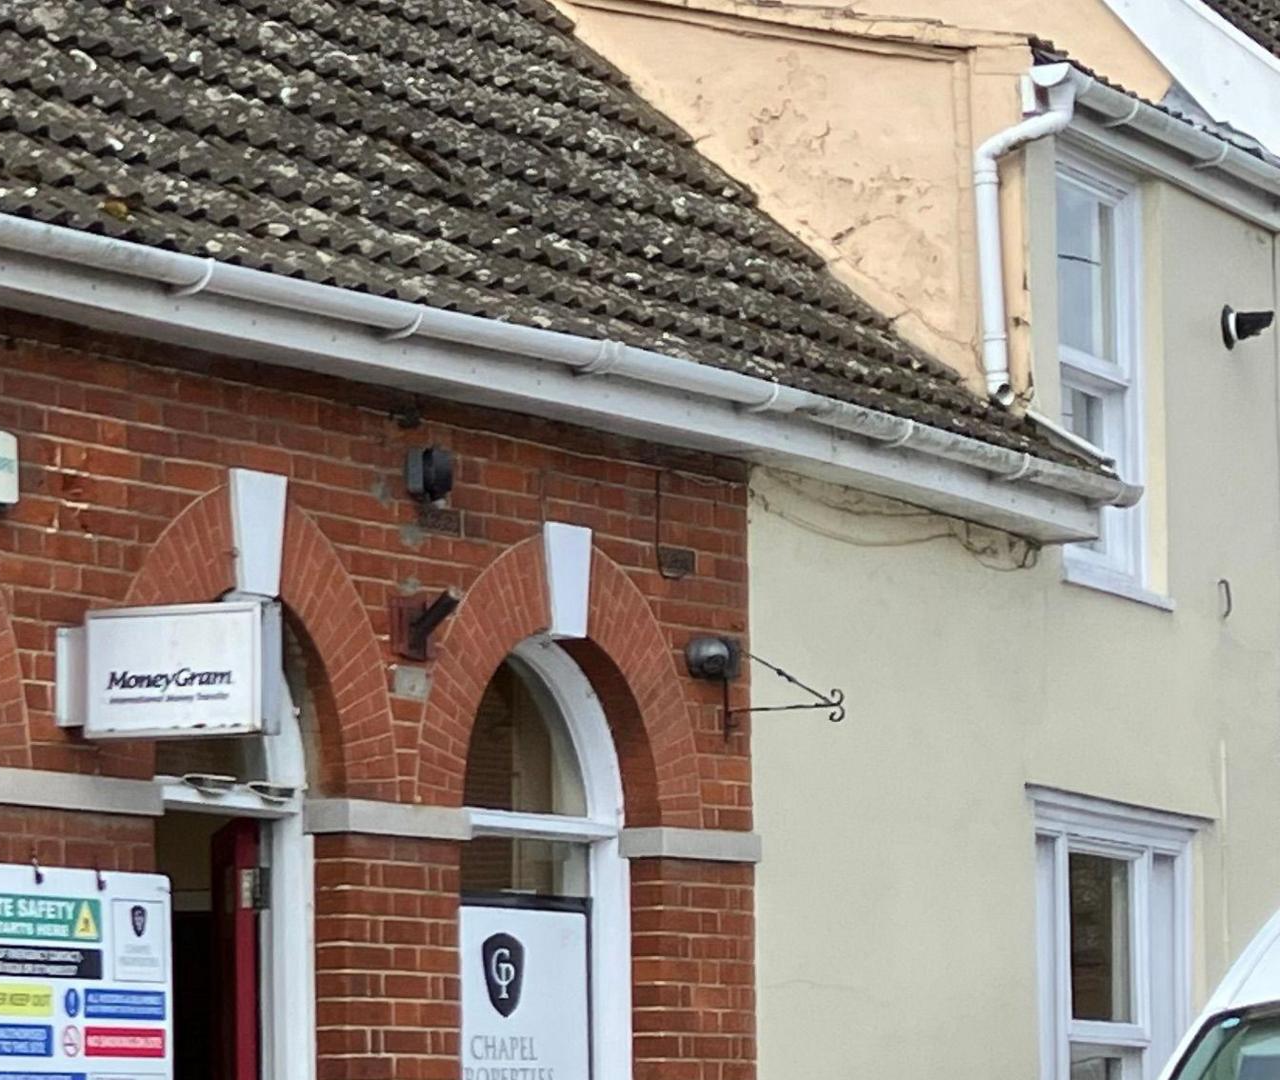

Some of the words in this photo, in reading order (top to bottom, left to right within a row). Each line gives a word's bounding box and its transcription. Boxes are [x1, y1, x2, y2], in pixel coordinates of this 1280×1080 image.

[106, 667, 233, 693] MoneyGram
[17, 899, 76, 920] SAFETY
[470, 1035, 538, 1060] CHAPEL
